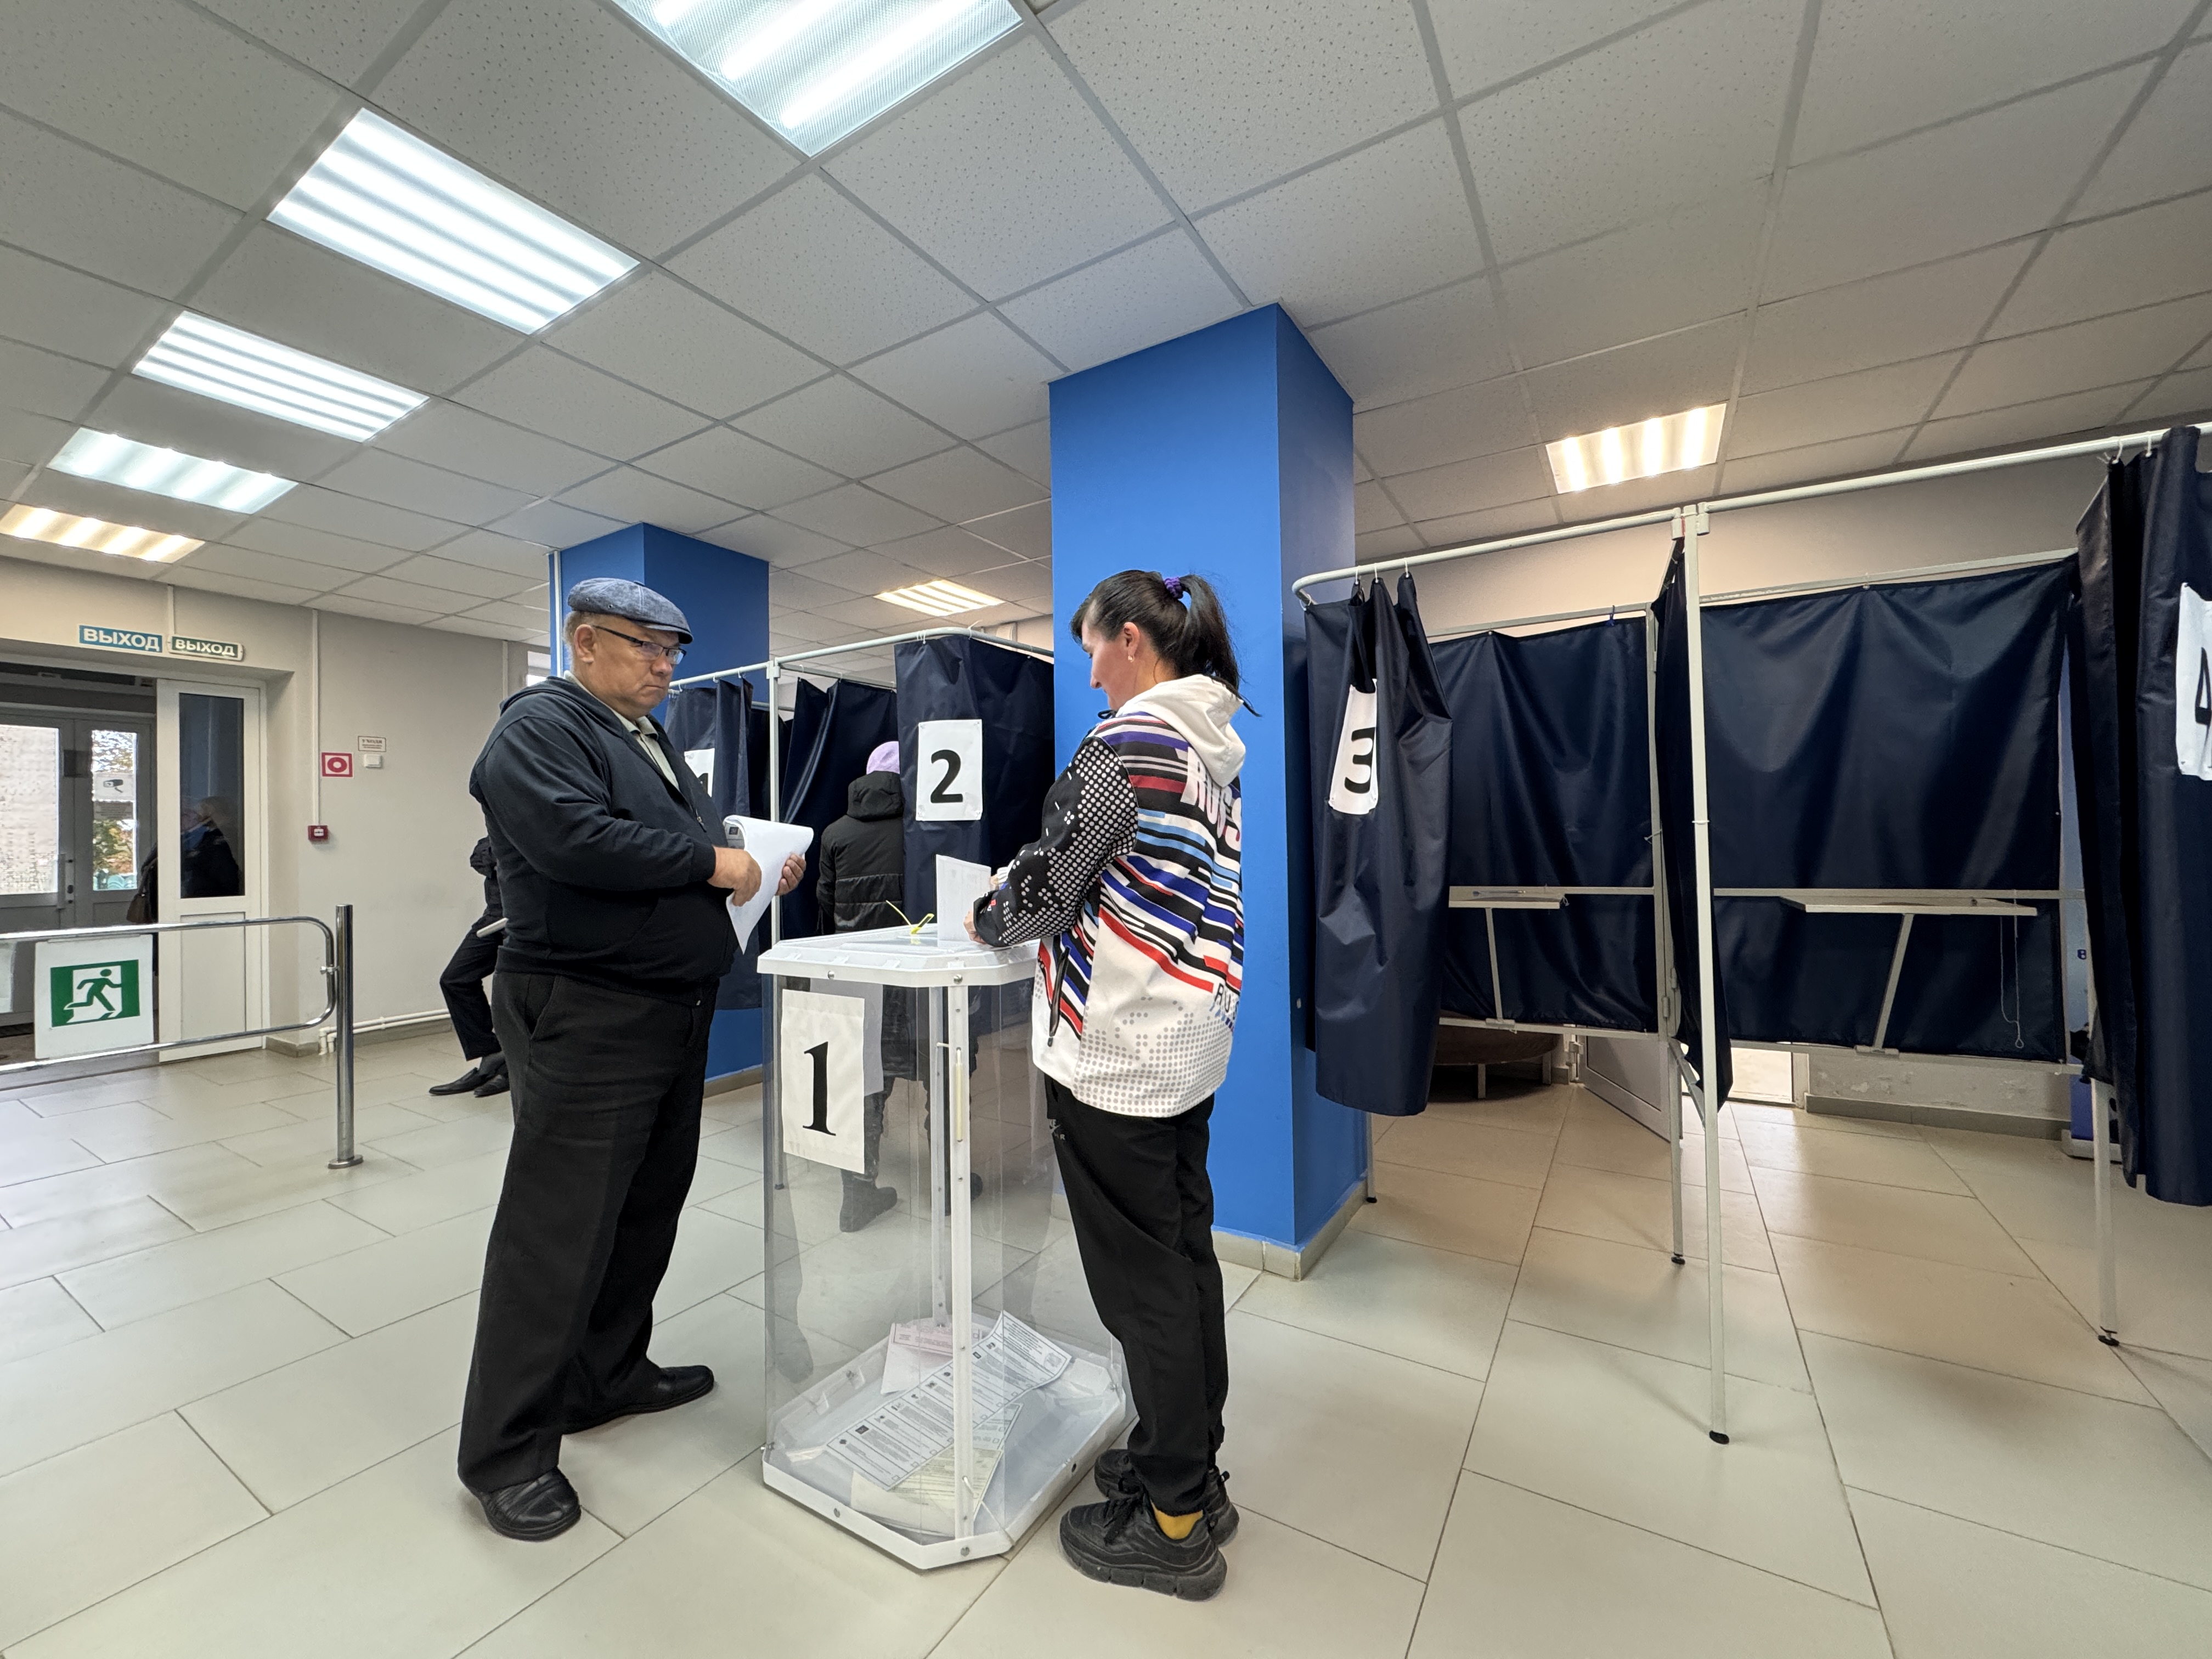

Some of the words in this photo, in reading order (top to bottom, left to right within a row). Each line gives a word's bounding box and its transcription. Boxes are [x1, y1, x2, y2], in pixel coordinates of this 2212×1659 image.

[83, 628, 160, 652] ВЫХОД
[175, 639, 235, 656] ВЫХОД
[930, 749, 963, 803] 2
[1344, 726, 1375, 794] 3
[803, 1041, 837, 1136] 1
